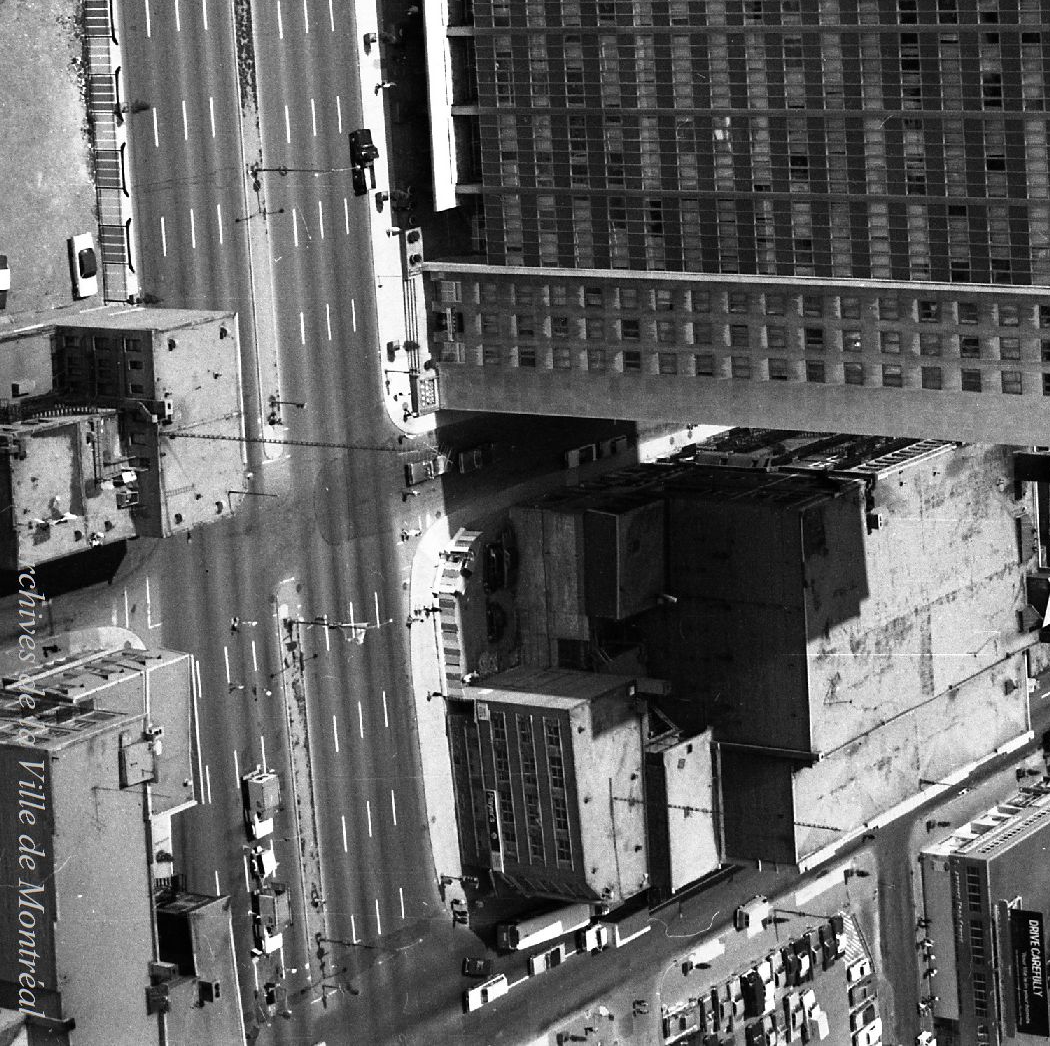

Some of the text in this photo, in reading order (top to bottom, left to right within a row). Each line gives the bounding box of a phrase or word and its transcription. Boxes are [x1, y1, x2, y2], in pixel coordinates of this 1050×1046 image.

[487, 793, 495, 822] Player's
[1029, 919, 1042, 997] DRIVE CAREFULLY
